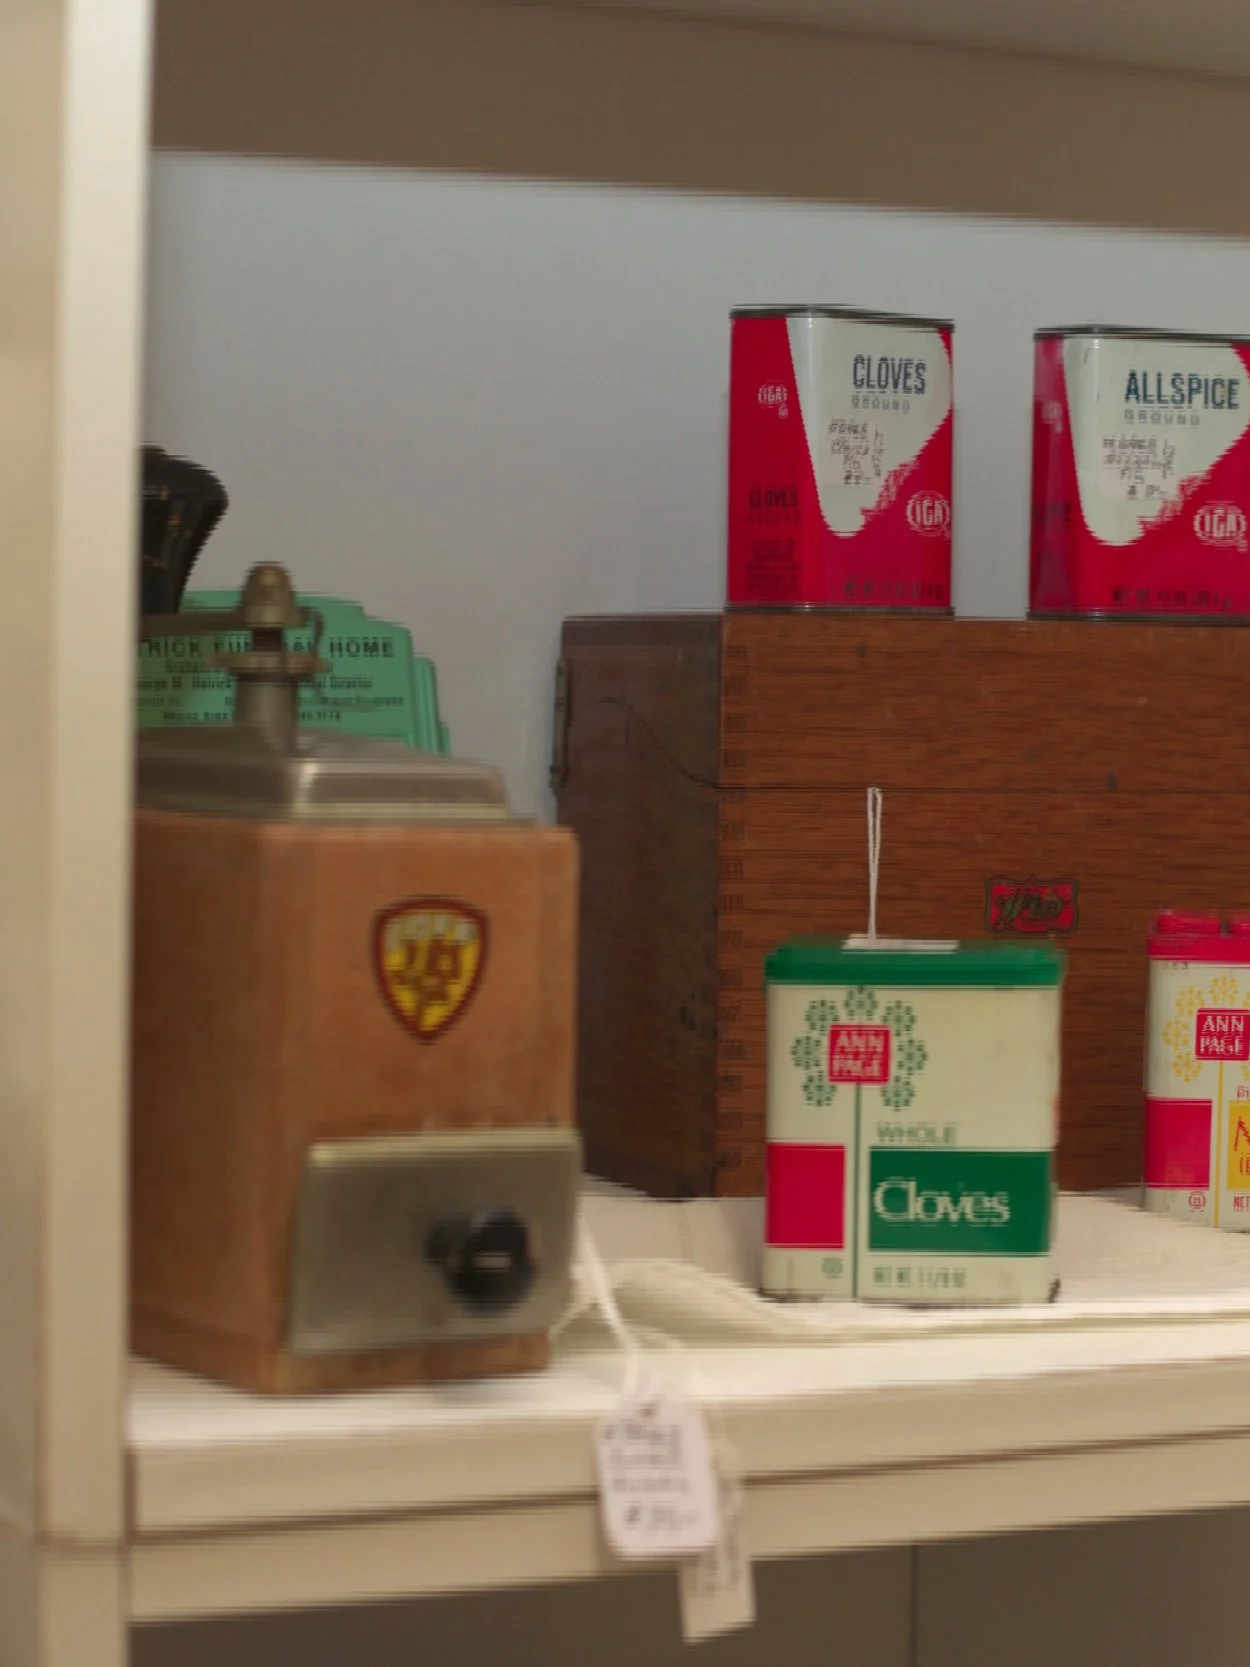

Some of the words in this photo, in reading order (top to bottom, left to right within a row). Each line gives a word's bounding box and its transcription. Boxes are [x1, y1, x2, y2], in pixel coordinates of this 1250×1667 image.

[852, 354, 926, 394] CLOVES
[1124, 369, 1240, 410] ALLSPICE
[1124, 408, 1200, 426] GROUND
[1202, 507, 1239, 537] IGA
[329, 636, 395, 658] HOME
[1202, 1015, 1244, 1033] ANN
[836, 1030, 884, 1049] ANN
[1200, 1036, 1244, 1055] PAGE
[832, 1056, 883, 1076] PAGE
[876, 1122, 958, 1143] WHOLE
[873, 1178, 1011, 1226] Cloves
[1233, 1195, 1250, 1213] NET
